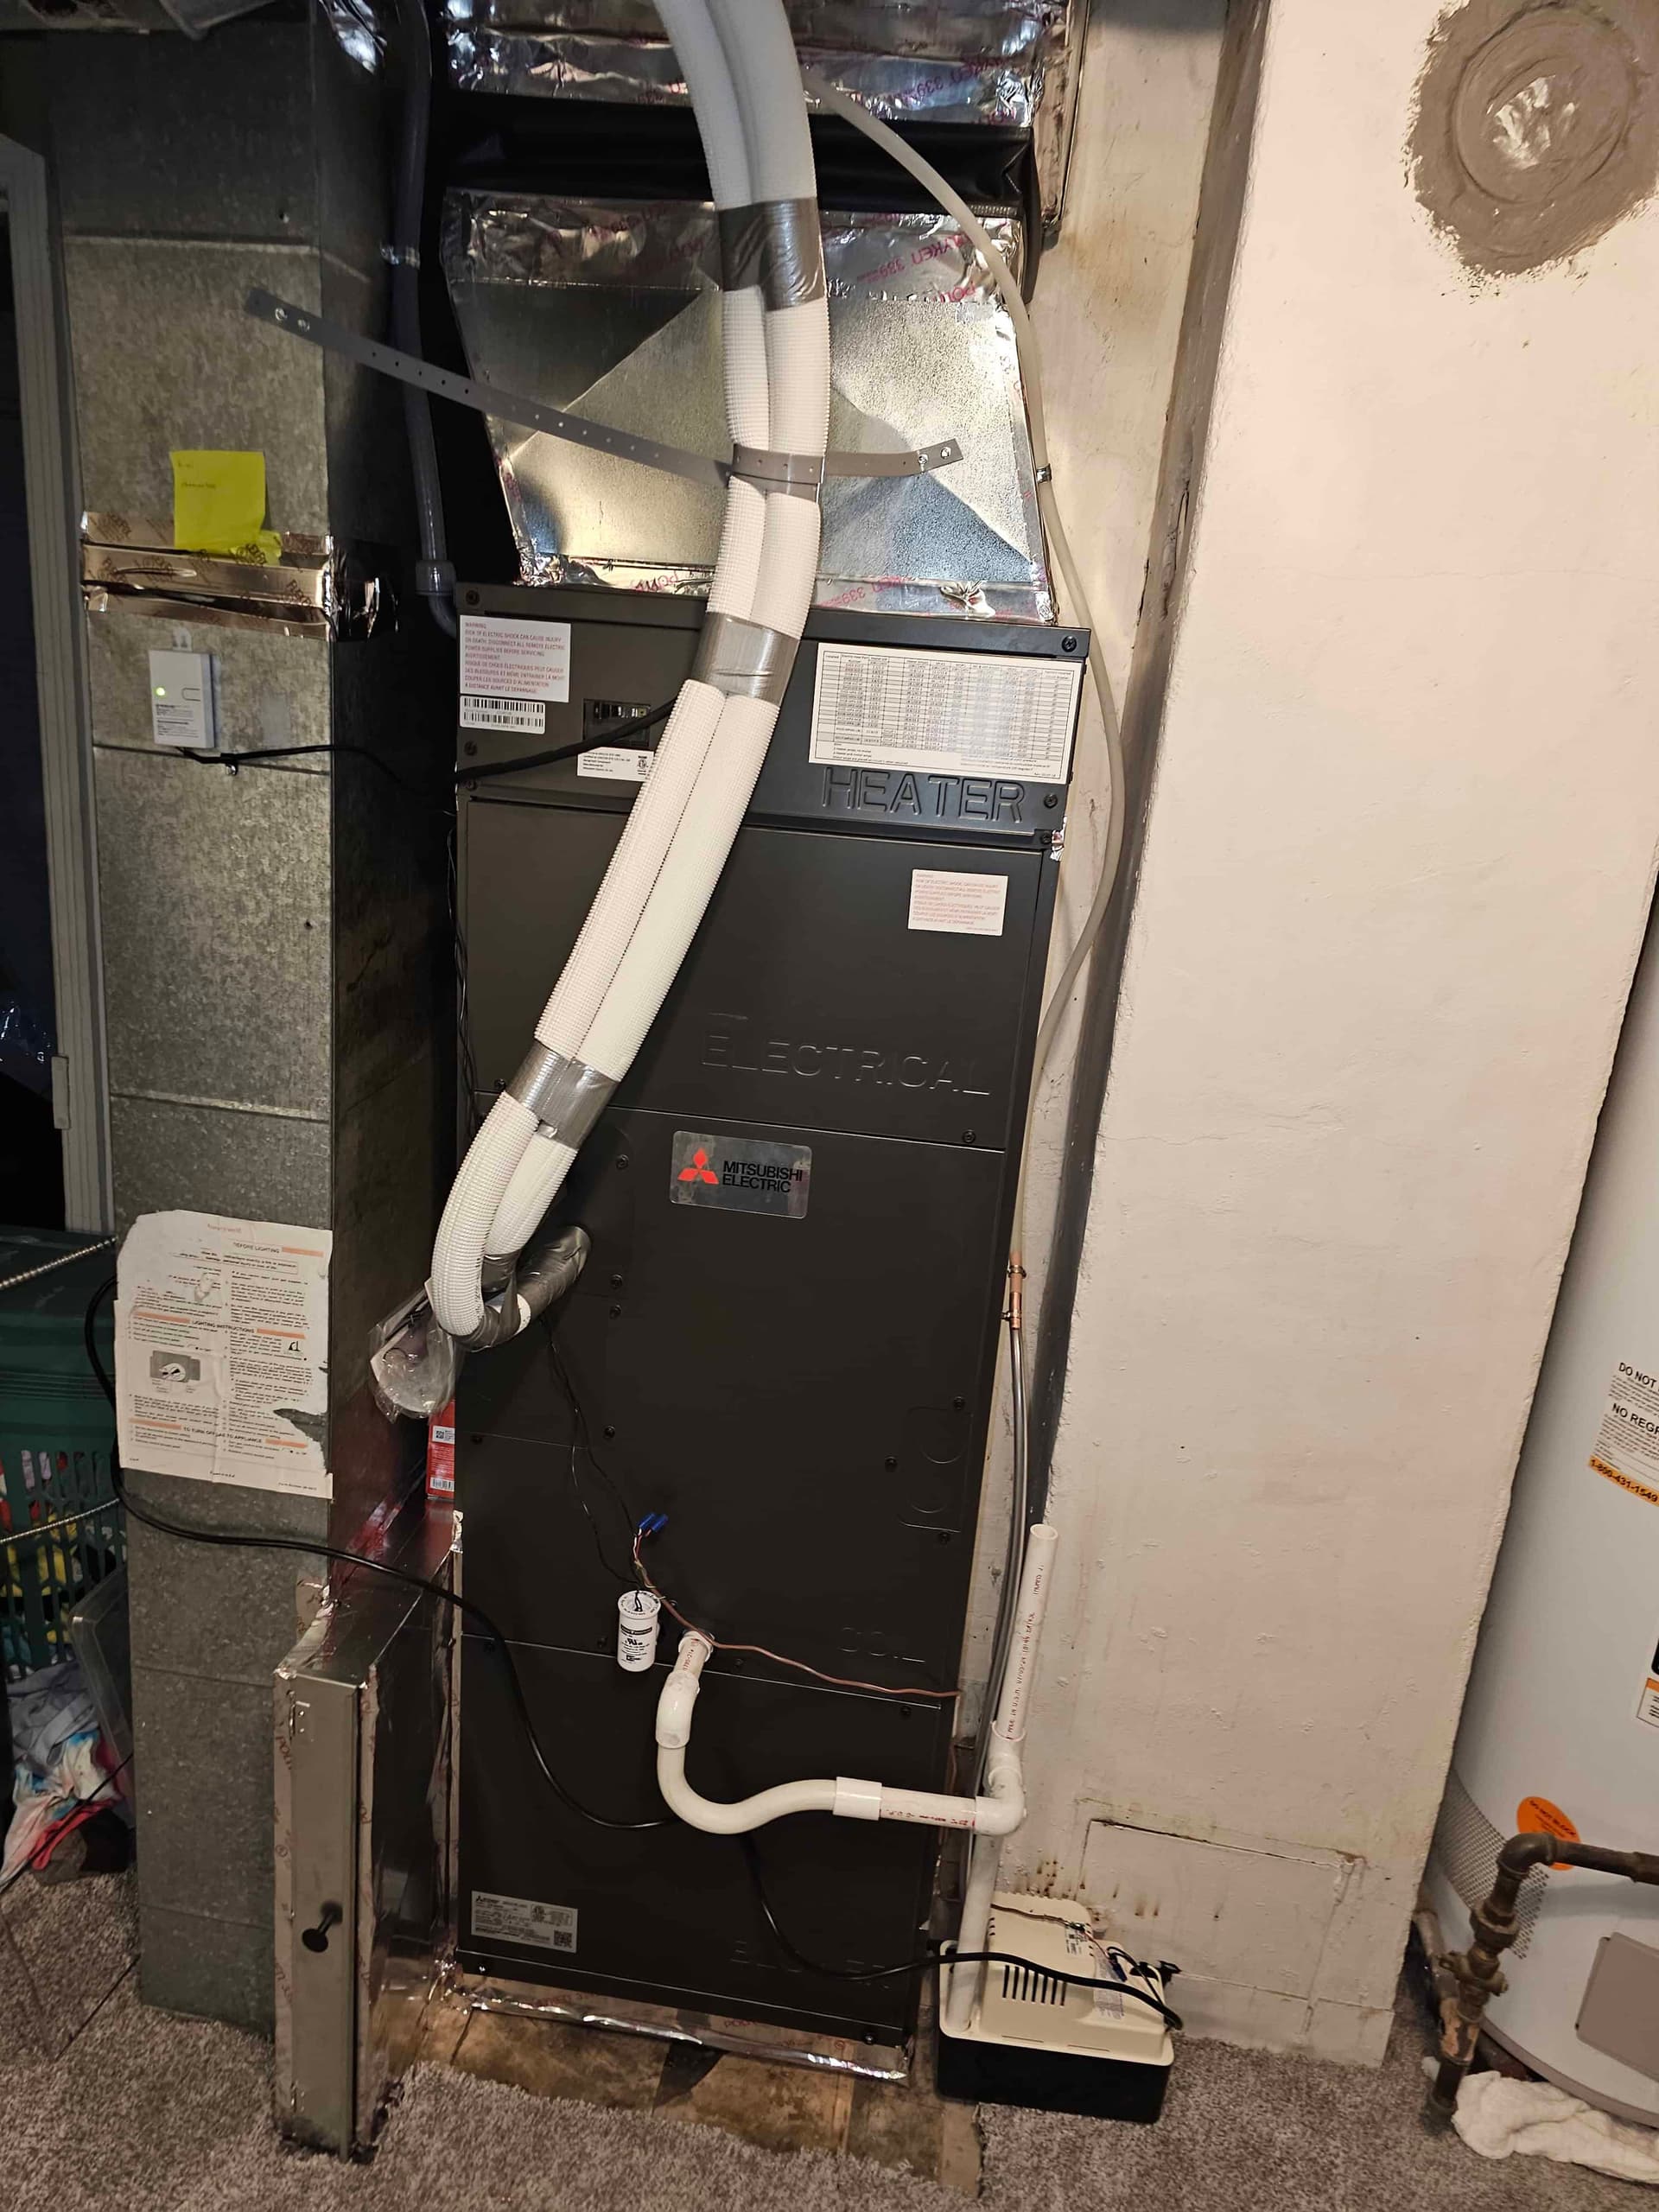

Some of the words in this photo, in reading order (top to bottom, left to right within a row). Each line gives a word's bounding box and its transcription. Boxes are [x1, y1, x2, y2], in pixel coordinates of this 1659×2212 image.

[822, 766, 1026, 823] HEATER
[701, 1034, 990, 1096] ELECTRICAL
[722, 1160, 804, 1182] MITSUBISHI
[721, 1173, 791, 1194] ELECTRIC
[1618, 1362, 1633, 1376] DO
[1634, 1370, 1657, 1389] NOT
[1611, 1402, 1628, 1419] NO
